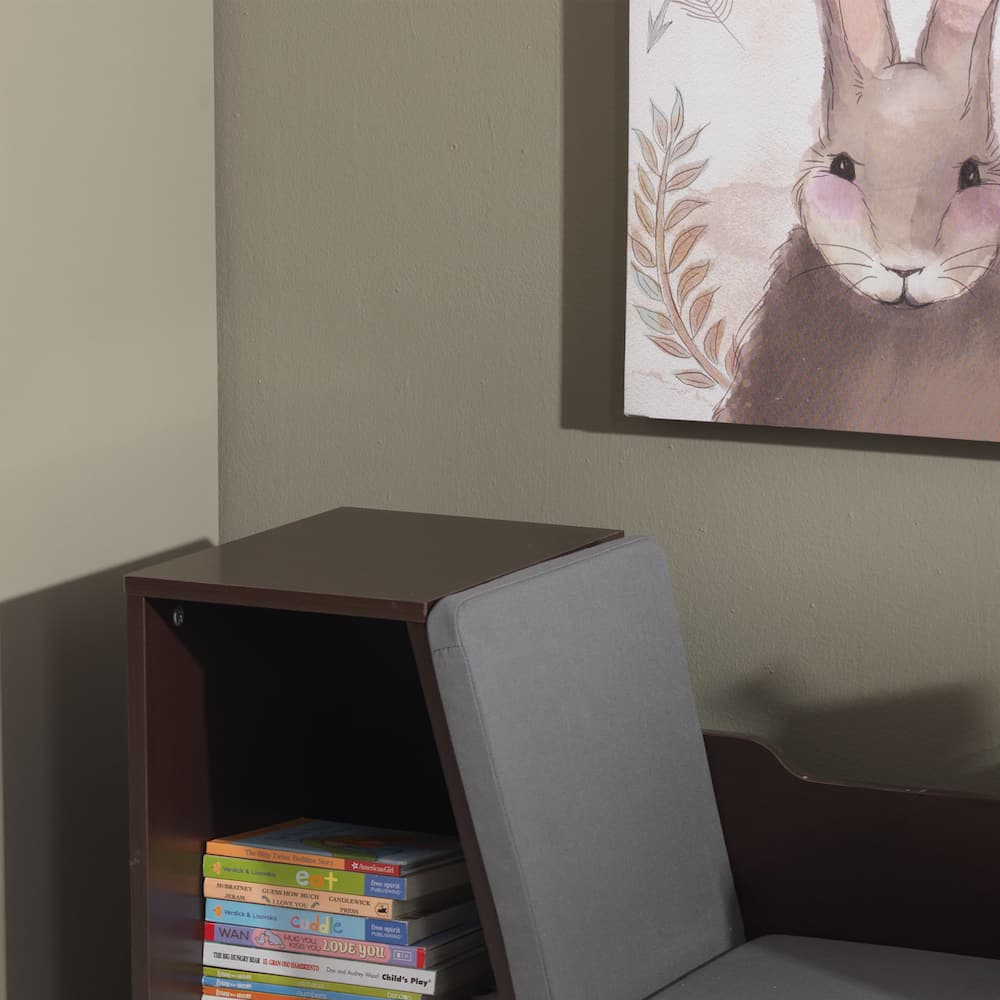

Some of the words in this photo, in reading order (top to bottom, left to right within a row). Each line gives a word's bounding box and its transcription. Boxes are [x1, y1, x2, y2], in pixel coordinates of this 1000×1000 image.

[295, 870, 338, 891] eat
[218, 926, 250, 941] WAN
[382, 974, 408, 984] Child's
[410, 977, 428, 987] Play
